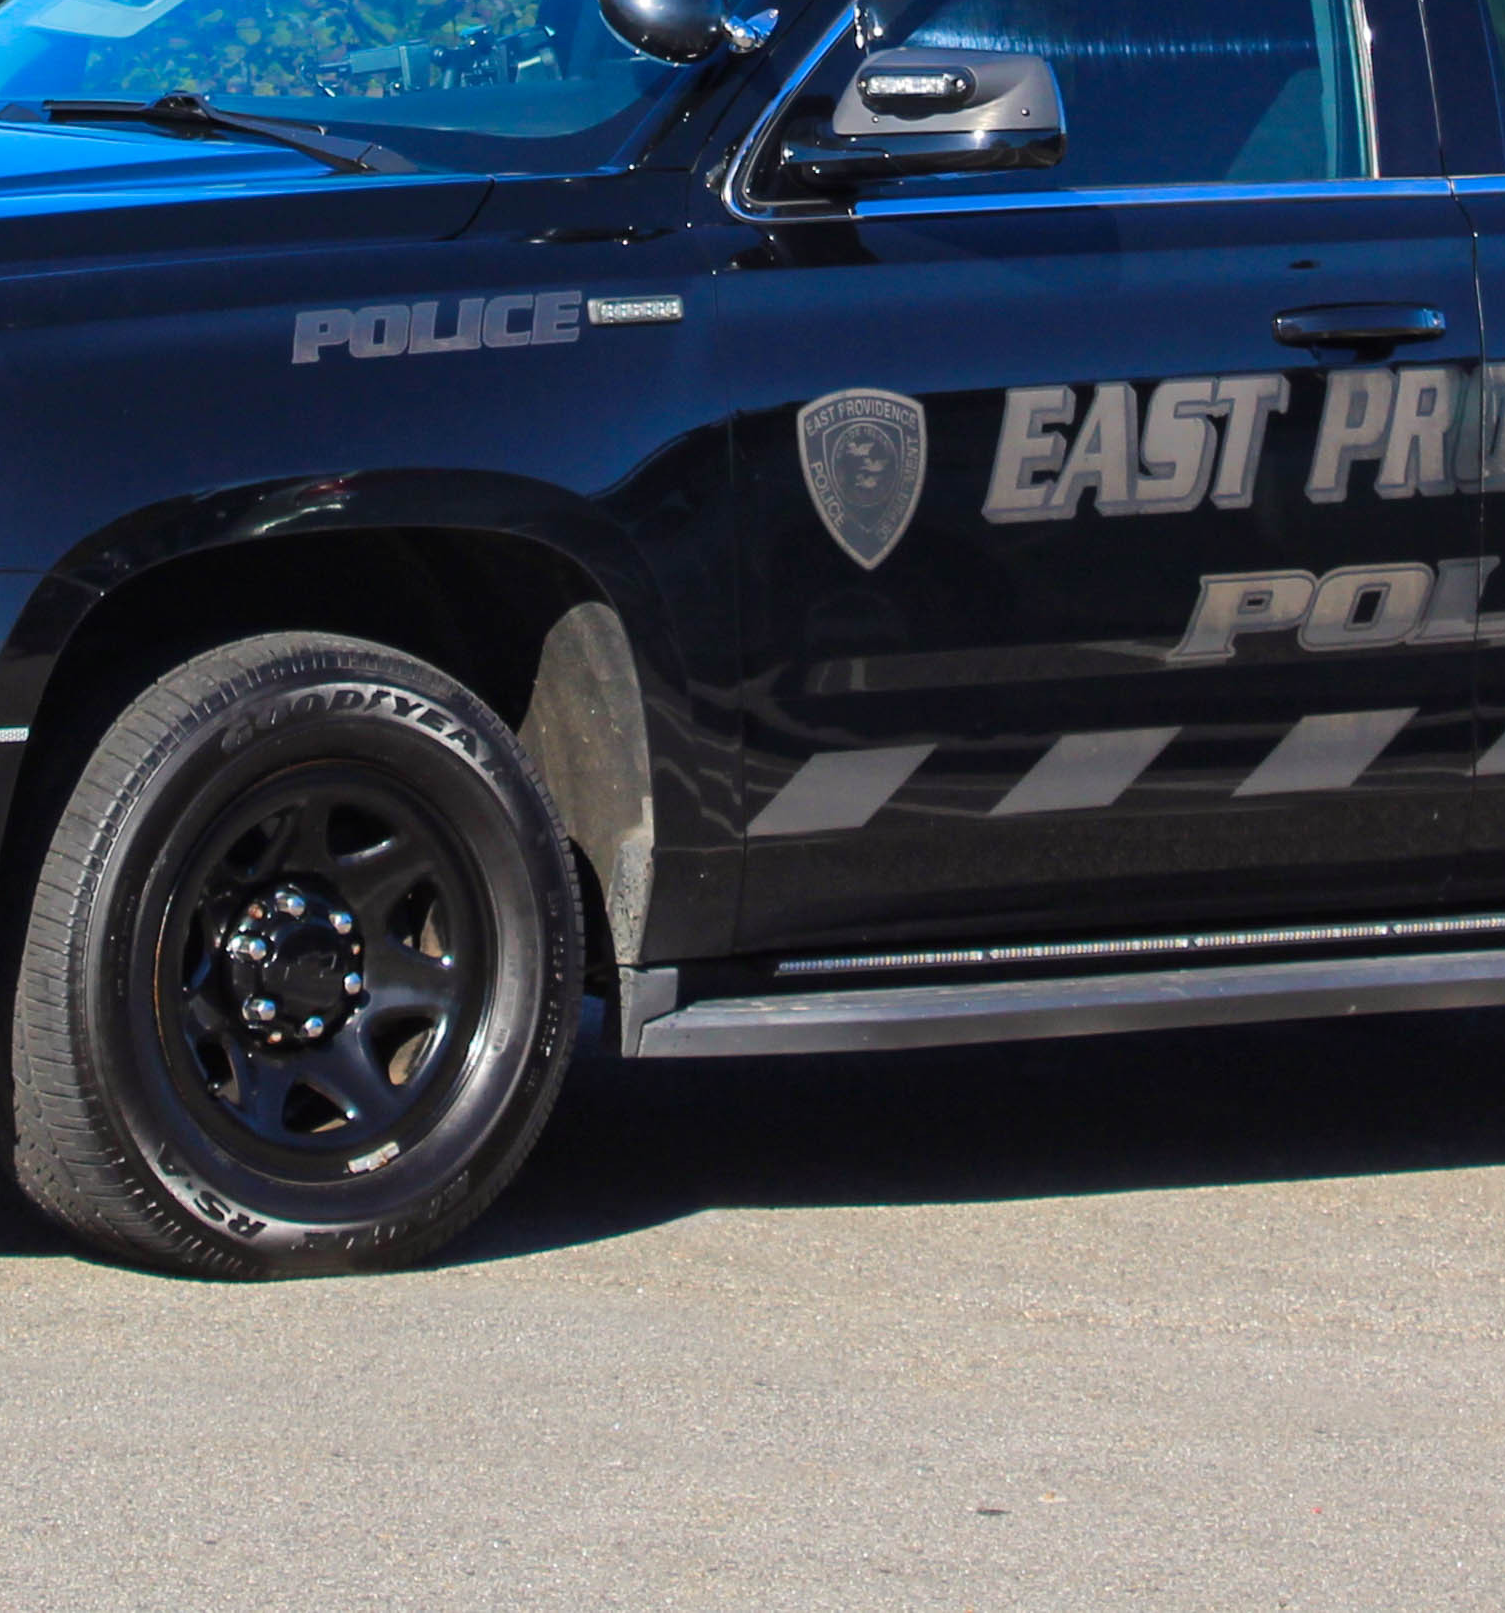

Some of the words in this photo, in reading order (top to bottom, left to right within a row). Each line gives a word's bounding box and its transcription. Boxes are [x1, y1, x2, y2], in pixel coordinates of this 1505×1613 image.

[291, 291, 582, 364] POLICE
[805, 405, 836, 437] EAST
[837, 398, 918, 431] PROVIDENCE
[981, 372, 1291, 524] EAST
[810, 460, 845, 528] POLICE
